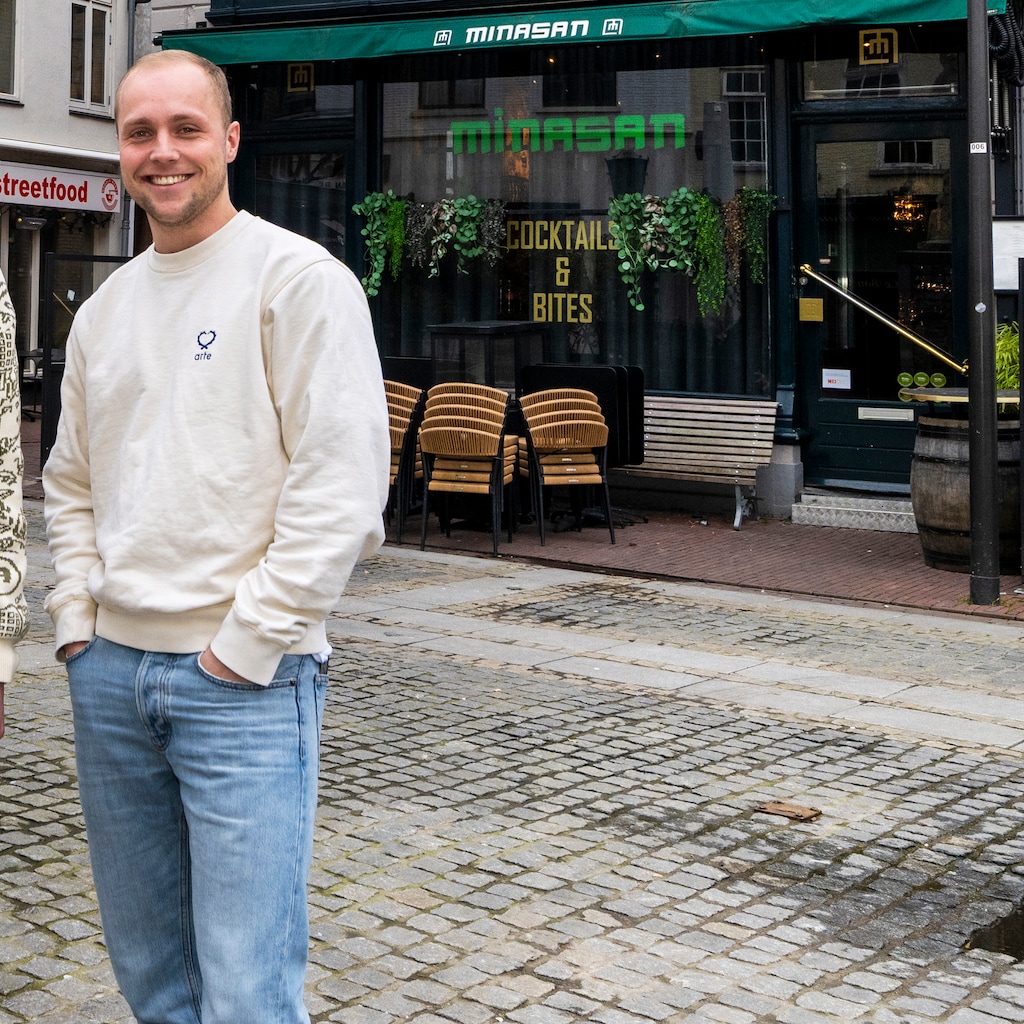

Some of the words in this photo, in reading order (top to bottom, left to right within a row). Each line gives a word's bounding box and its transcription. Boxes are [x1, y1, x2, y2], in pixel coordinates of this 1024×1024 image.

[555, 257, 571, 287] &
[533, 293, 593, 324] BITES
[194, 351, 212, 361] arte
